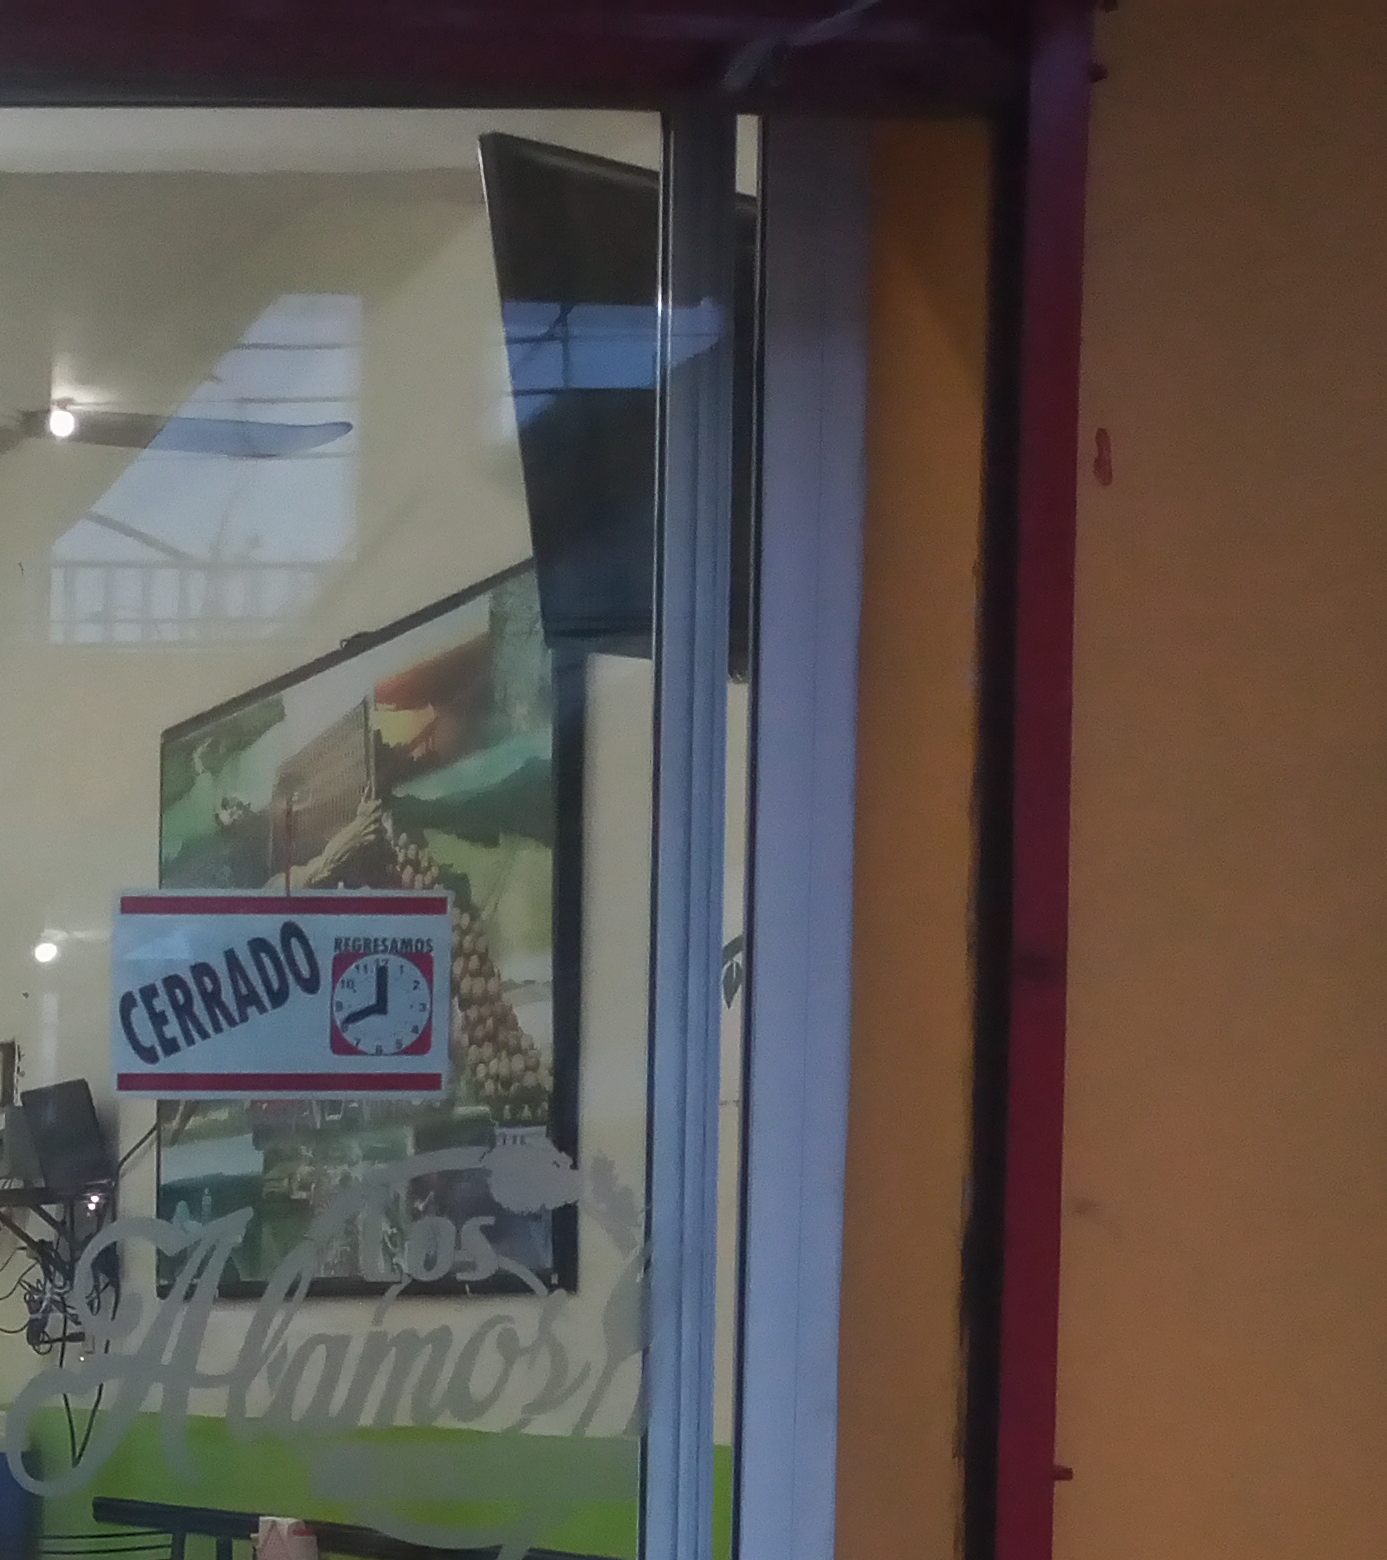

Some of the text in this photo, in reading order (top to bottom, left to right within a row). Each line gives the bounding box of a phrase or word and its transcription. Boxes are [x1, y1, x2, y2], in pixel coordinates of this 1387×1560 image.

[333, 936, 434, 953] REGRESAMOS
[413, 980, 420, 990] 2
[118, 920, 321, 1065] CERRADO
[419, 1002, 427, 1012] 3
[354, 1038, 361, 1047] 7
[6, 1205, 590, 1498] Alamos
